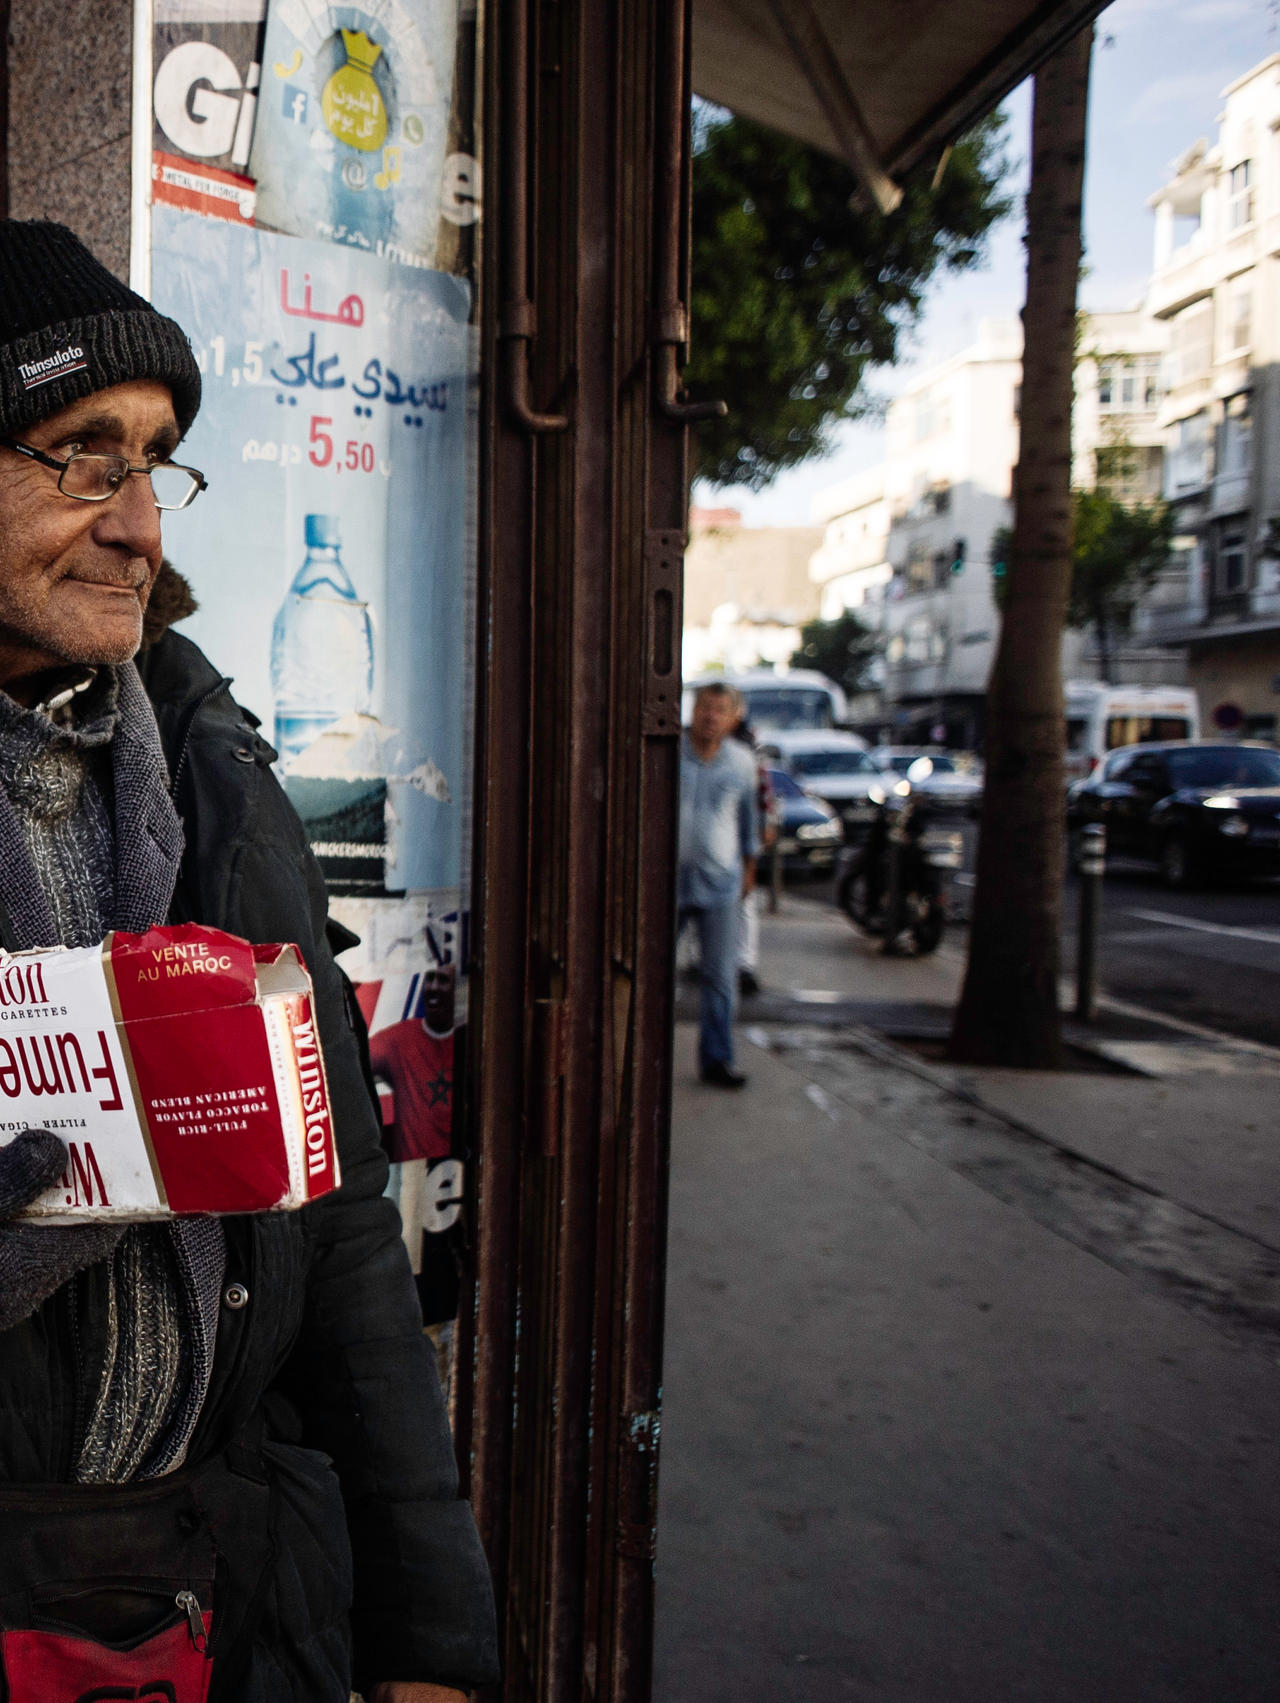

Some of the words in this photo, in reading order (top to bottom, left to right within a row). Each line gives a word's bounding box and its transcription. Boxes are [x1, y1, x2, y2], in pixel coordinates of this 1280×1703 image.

[280, 269, 364, 328] هنا
[270, 331, 345, 406] علي
[352, 358, 448, 428] سيدي
[242, 439, 302, 466] درهم
[308, 415, 375, 474] 5,50
[152, 942, 210, 963] VENTE
[137, 967, 160, 983] AU
[166, 955, 232, 978] MAROC
[151, 1096, 191, 1108] BLEND
[195, 1086, 266, 1105] AMERICAN
[292, 1018, 327, 1177] Winston
[42, 1118, 87, 1129] FILTER
[155, 1109, 201, 1123] FLAVOR
[206, 1101, 270, 1119] TOBACCO
